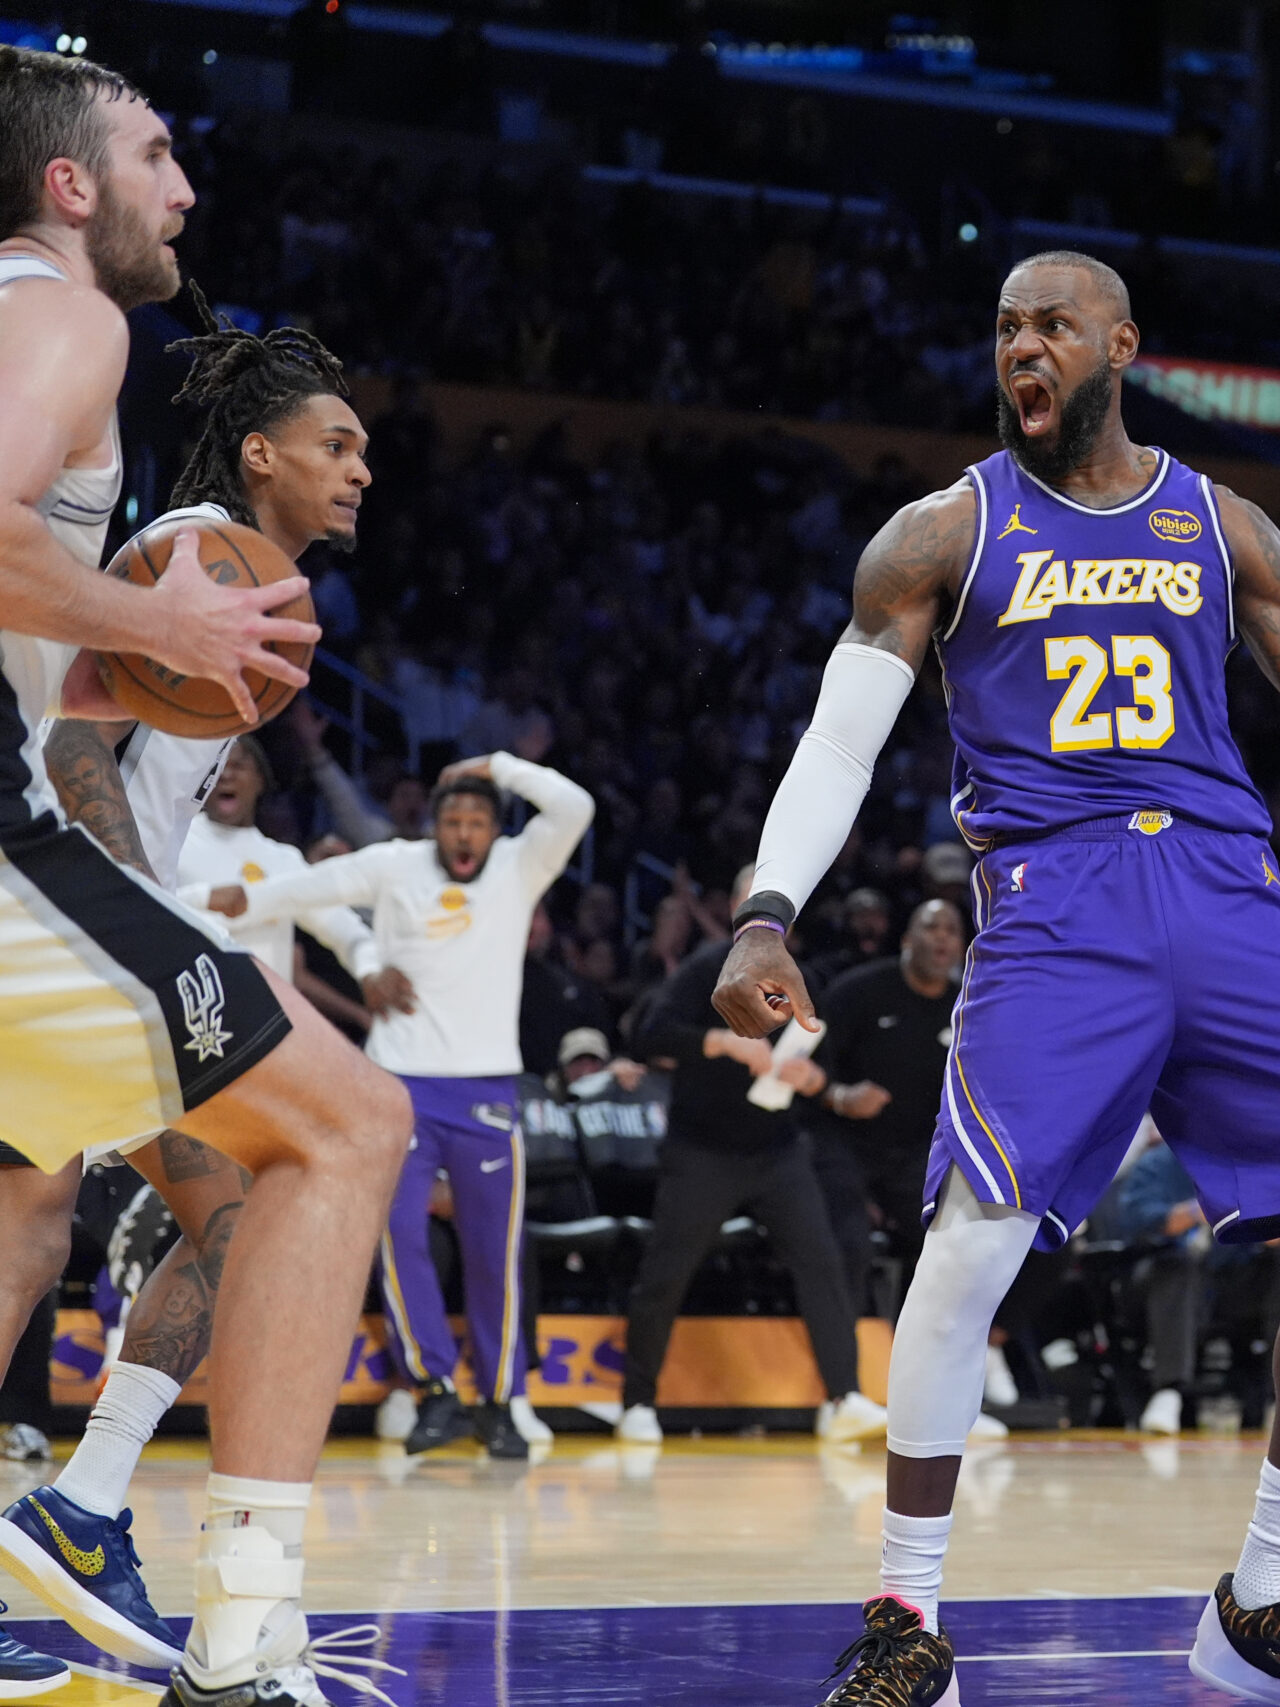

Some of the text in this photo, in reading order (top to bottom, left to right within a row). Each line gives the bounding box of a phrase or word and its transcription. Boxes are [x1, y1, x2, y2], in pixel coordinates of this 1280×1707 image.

[1153, 516, 1199, 534] bibigo
[997, 549, 1204, 628] LAKERS
[1043, 634, 1176, 753] 23
